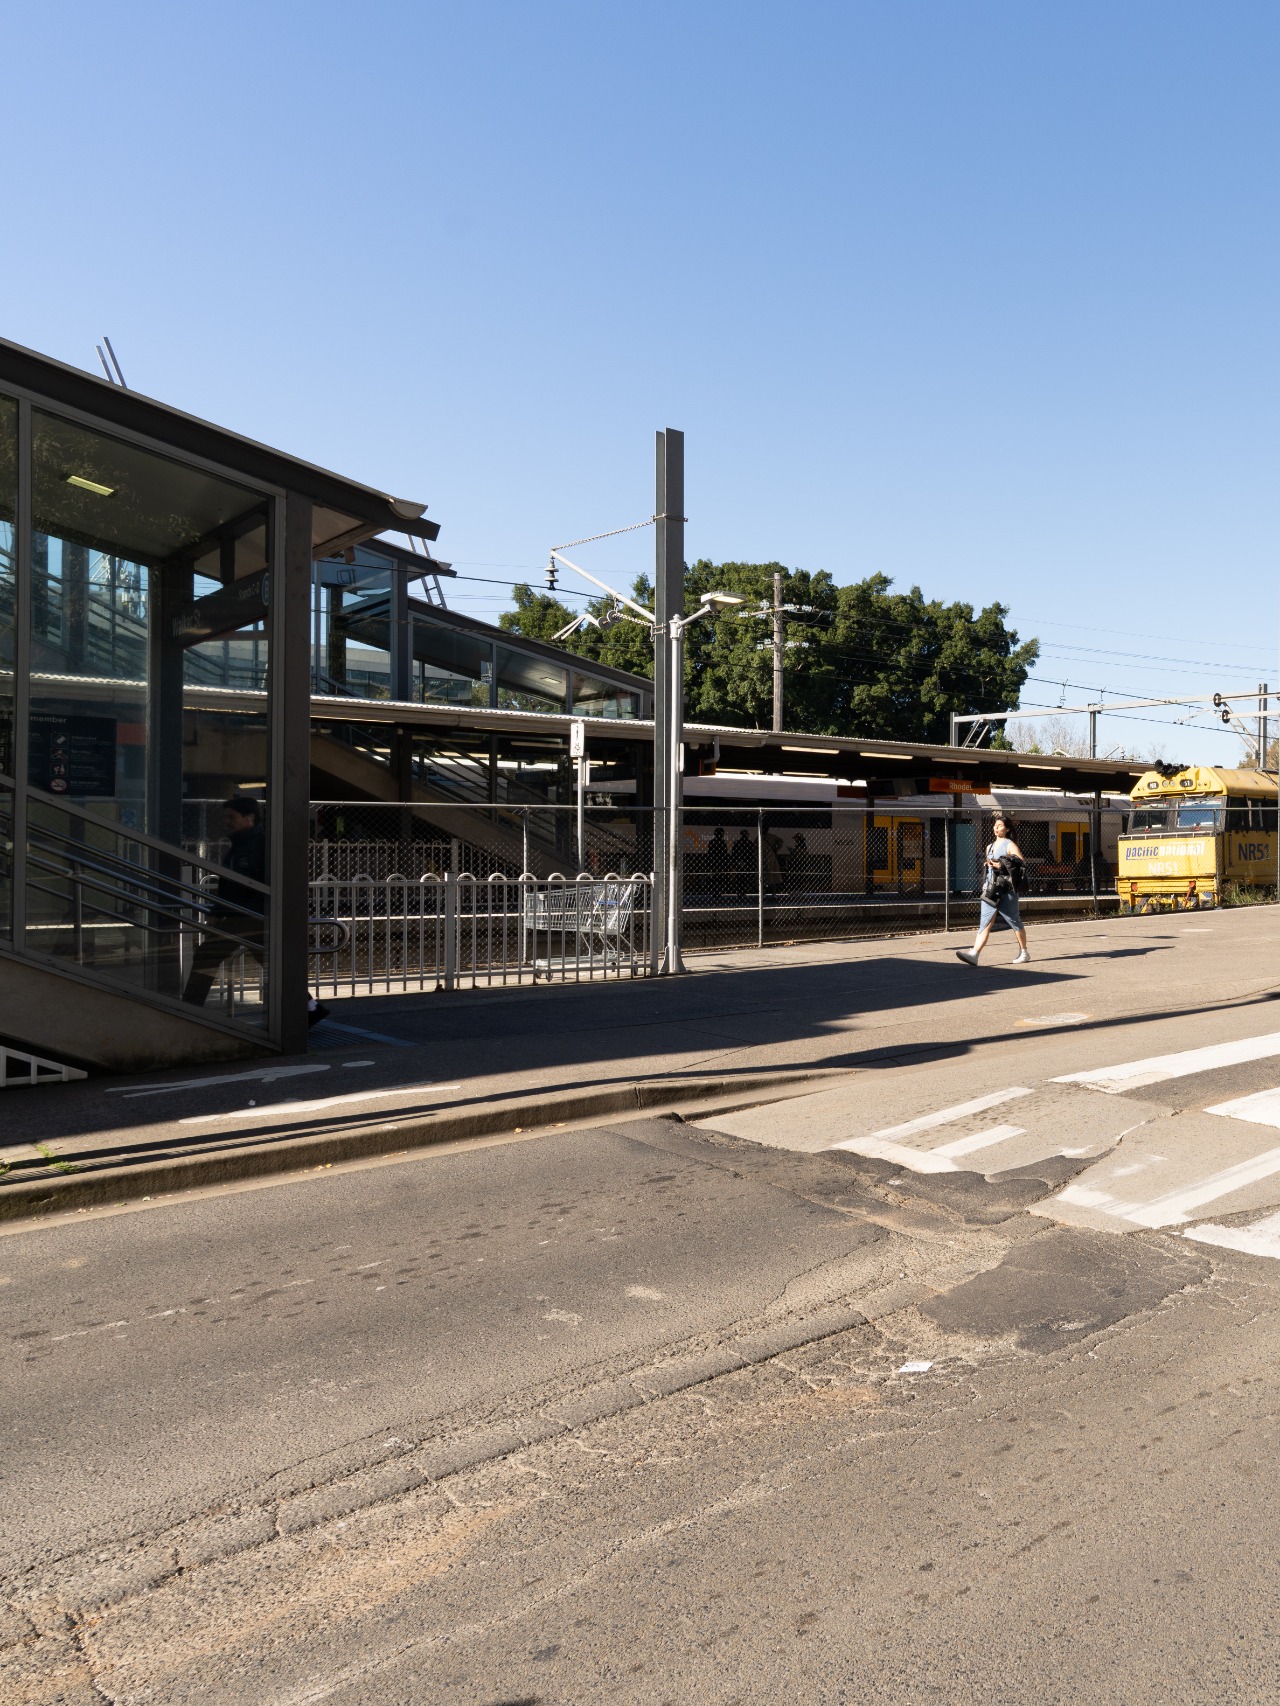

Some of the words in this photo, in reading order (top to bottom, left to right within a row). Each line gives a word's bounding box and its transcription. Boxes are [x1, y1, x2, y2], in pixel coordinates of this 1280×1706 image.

[1126, 846, 1159, 860] pacific
[1159, 841, 1205, 856] national
[1238, 843, 1269, 860] NR51
[1148, 862, 1178, 876] NR51
